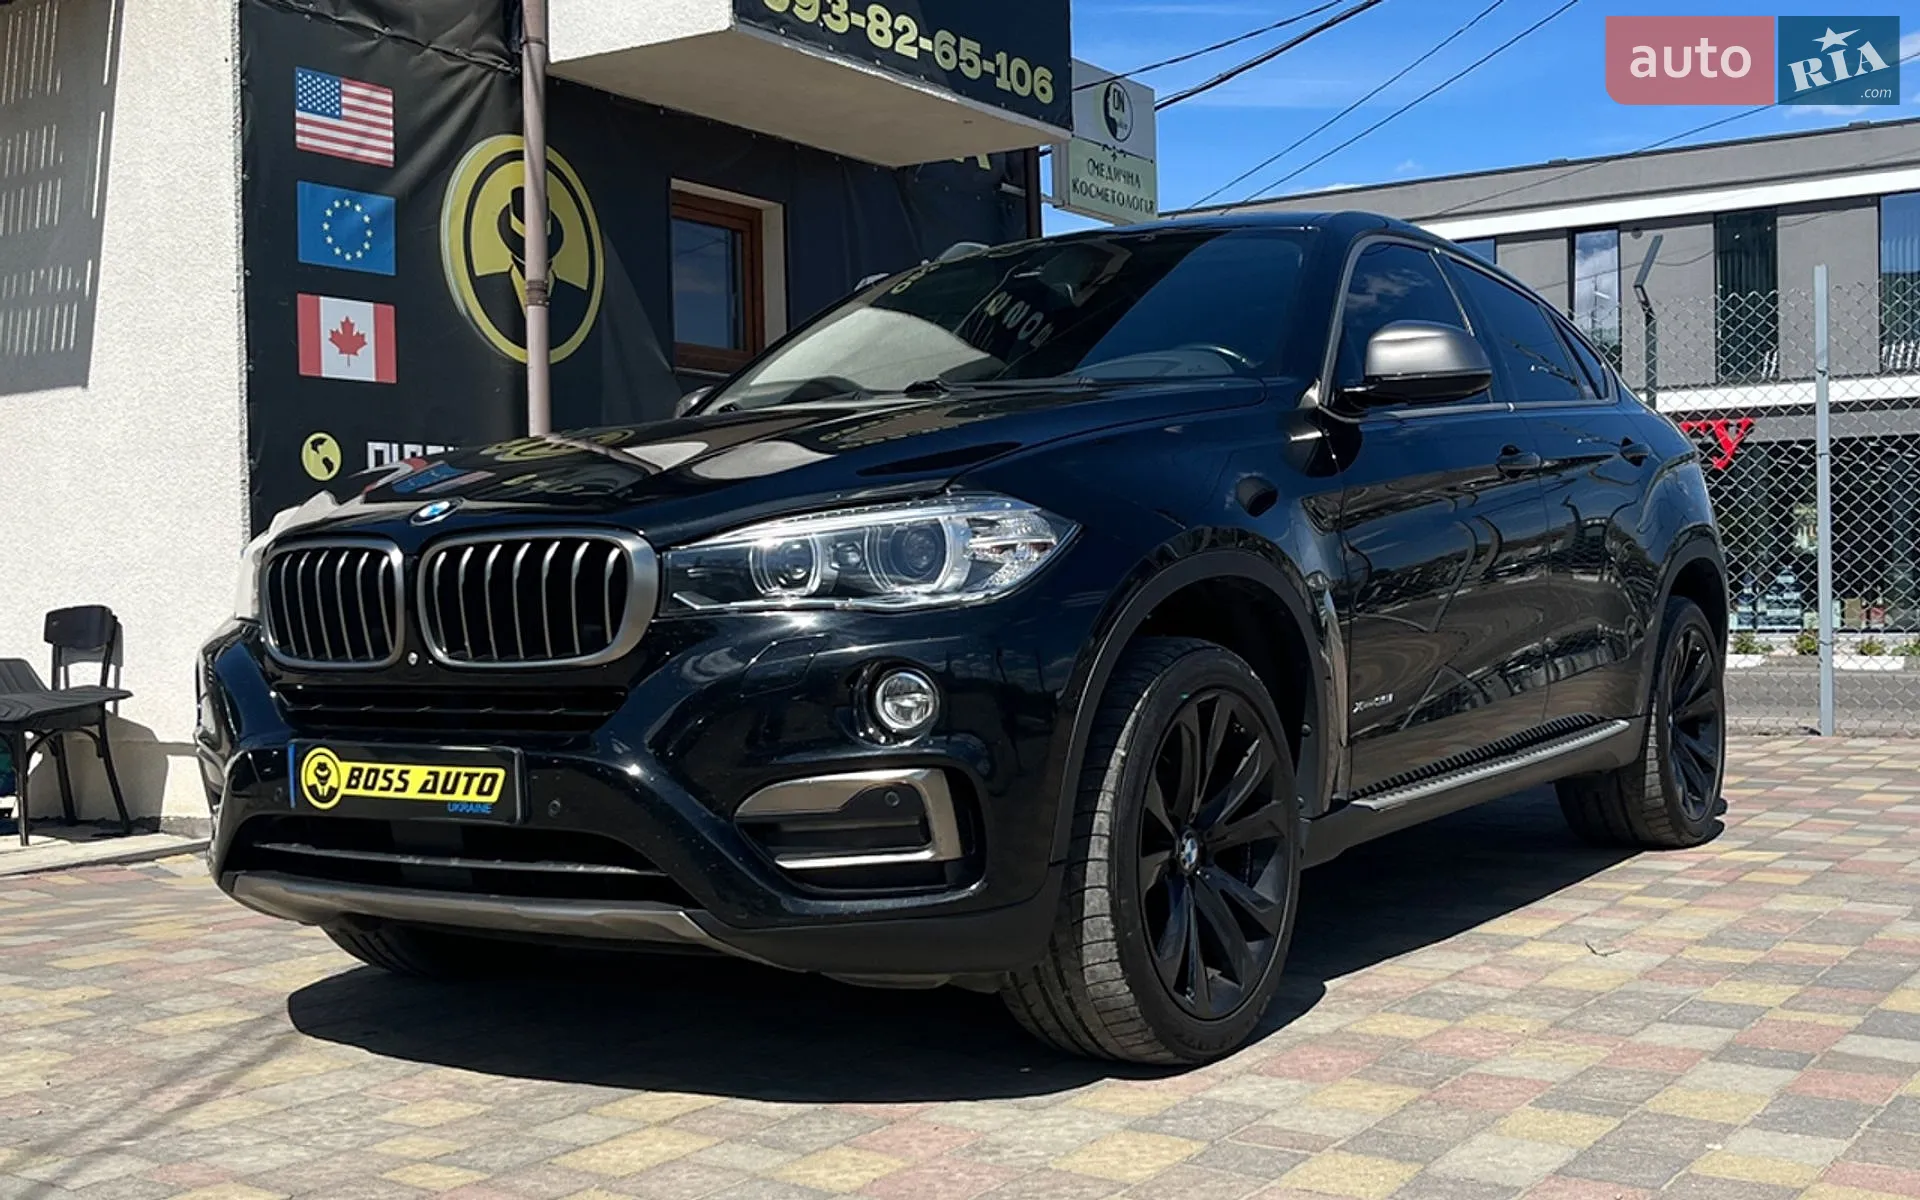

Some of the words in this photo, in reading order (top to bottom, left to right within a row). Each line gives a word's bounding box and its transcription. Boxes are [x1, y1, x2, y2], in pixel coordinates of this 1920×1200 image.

[345, 767, 410, 793] BOSS
[418, 771, 499, 797] AUTO
[447, 801, 493, 814] UKRAINE
